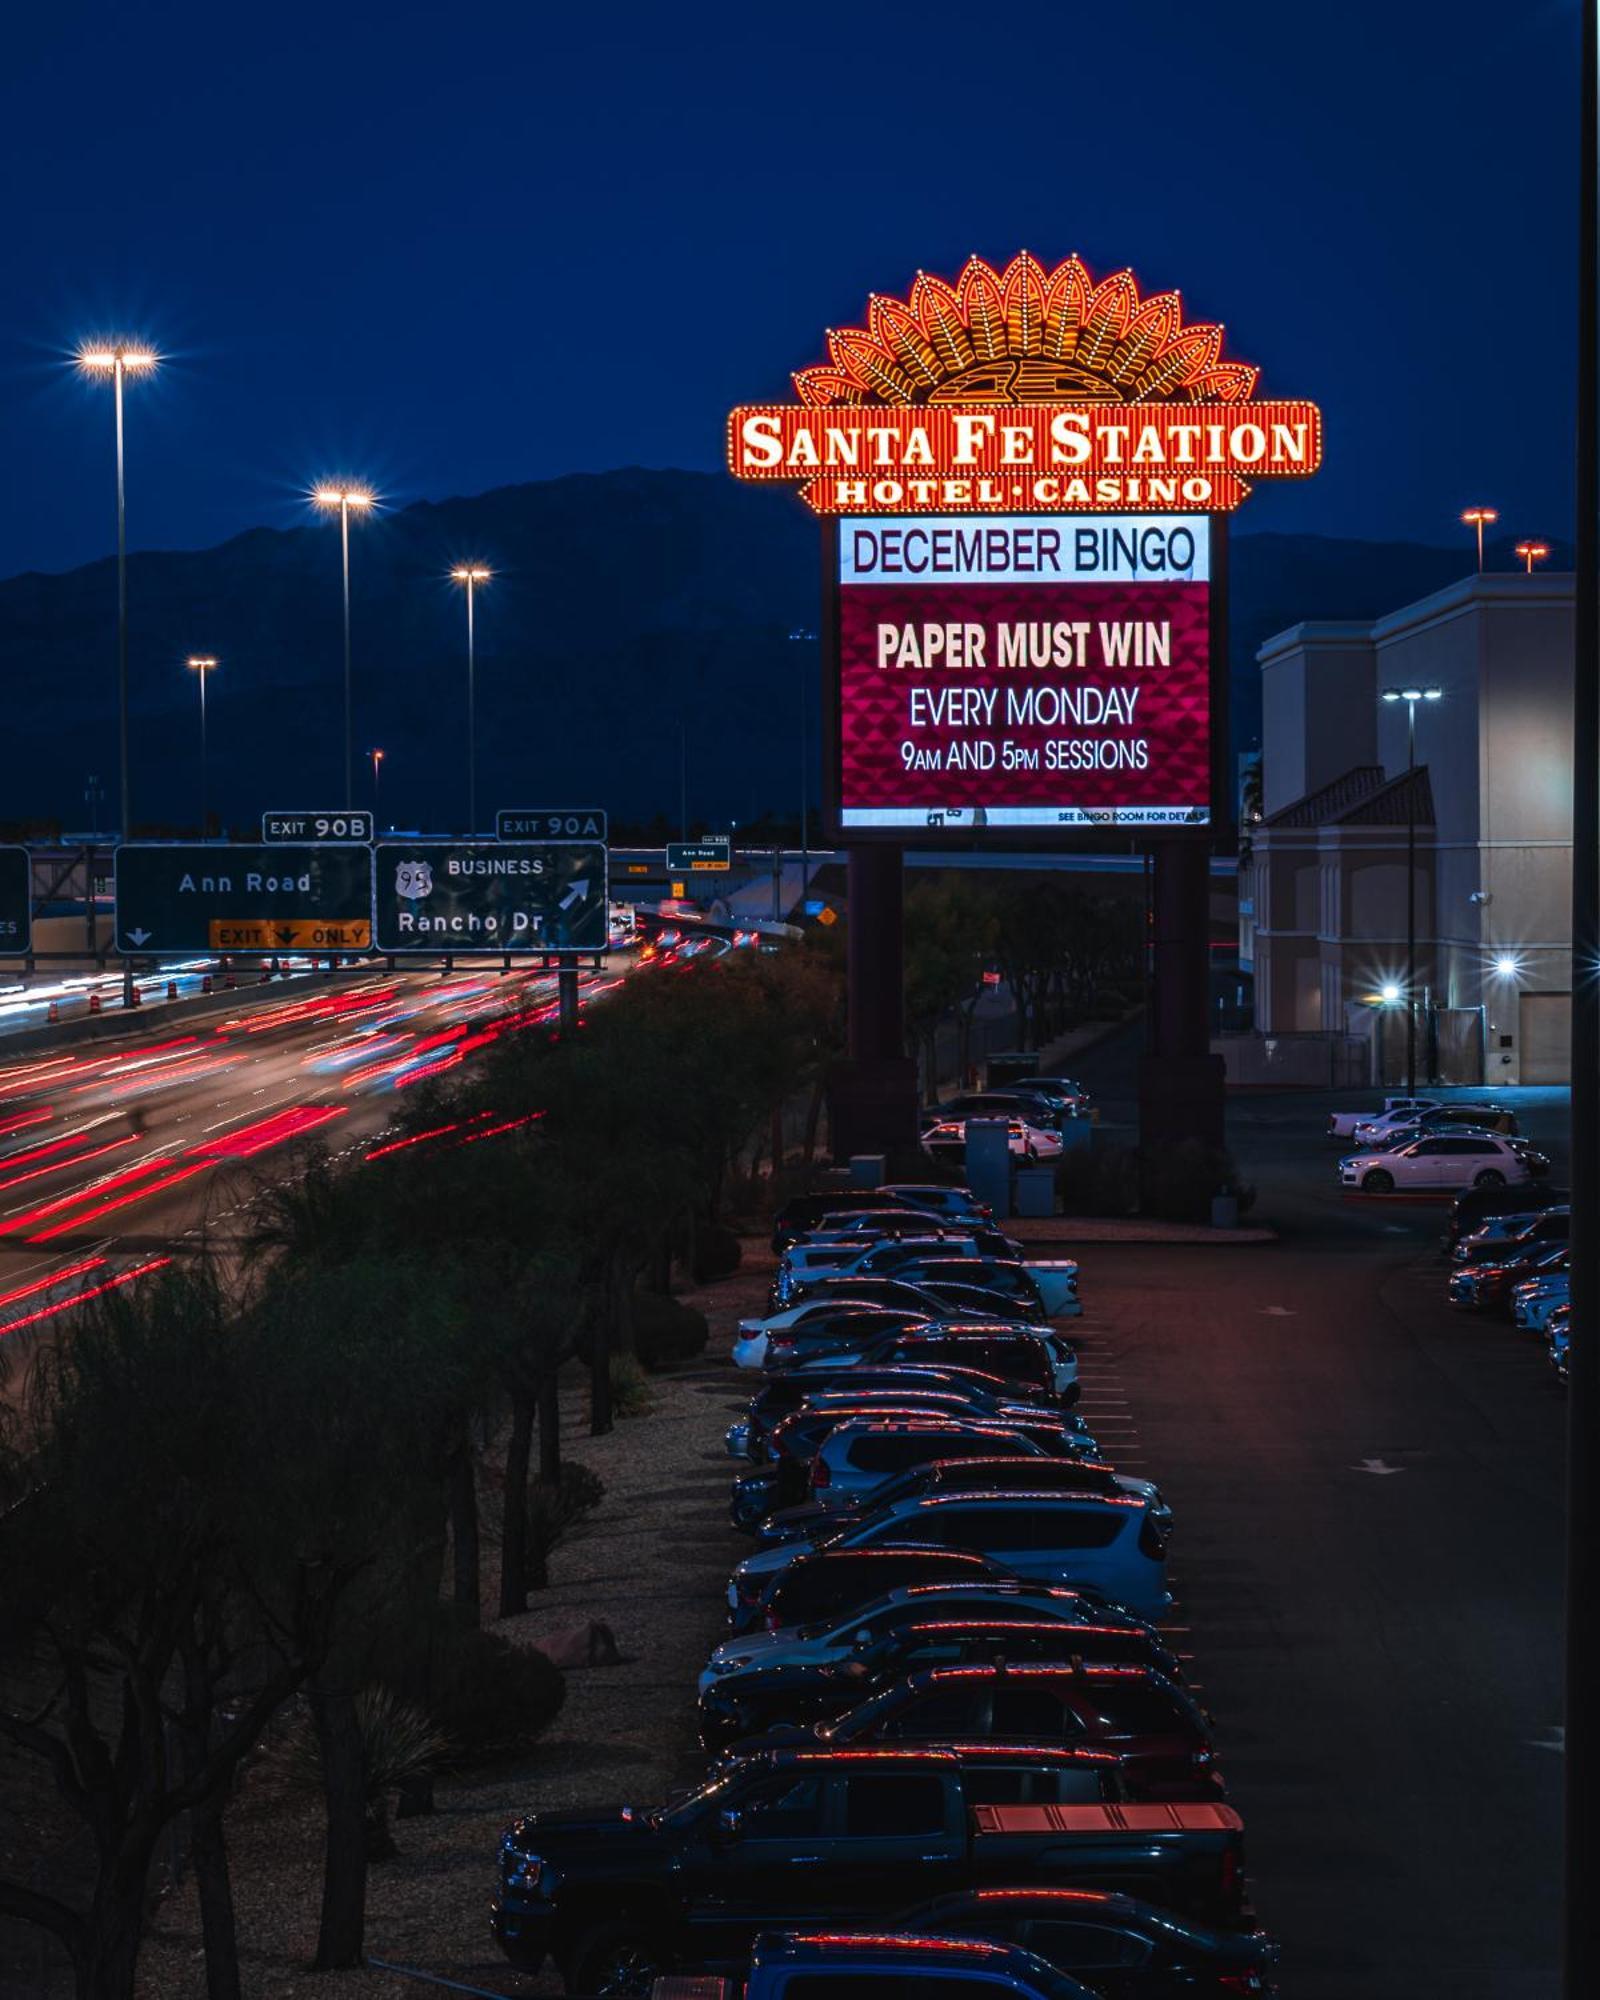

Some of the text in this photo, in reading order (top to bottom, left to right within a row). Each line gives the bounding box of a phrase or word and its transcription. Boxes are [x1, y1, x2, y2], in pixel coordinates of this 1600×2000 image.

[743, 412, 1309, 468] SANTA FE STATION
[836, 477, 1214, 504] HOTEL CASINO
[852, 526, 1196, 573] DECEMBER BINGO
[877, 621, 1171, 669] PAPER MUST WIN
[910, 686, 1140, 726] EVERY MONDAY
[900, 739, 1149, 771] 9AM AND 5PM SESSIONS
[503, 817, 599, 835] EXIT 90A
[1058, 812, 1075, 821] SEE
[1077, 812, 1110, 821] BINGO
[1113, 812, 1144, 821] ROOM
[1147, 812, 1166, 821] FOR
[270, 819, 366, 837] EXIT 90B
[448, 860, 544, 875] BUSINESS
[178, 873, 311, 892] Ann Road
[398, 912, 544, 931] Rancho Dr
[219, 929, 365, 944] EXIT ONLY
